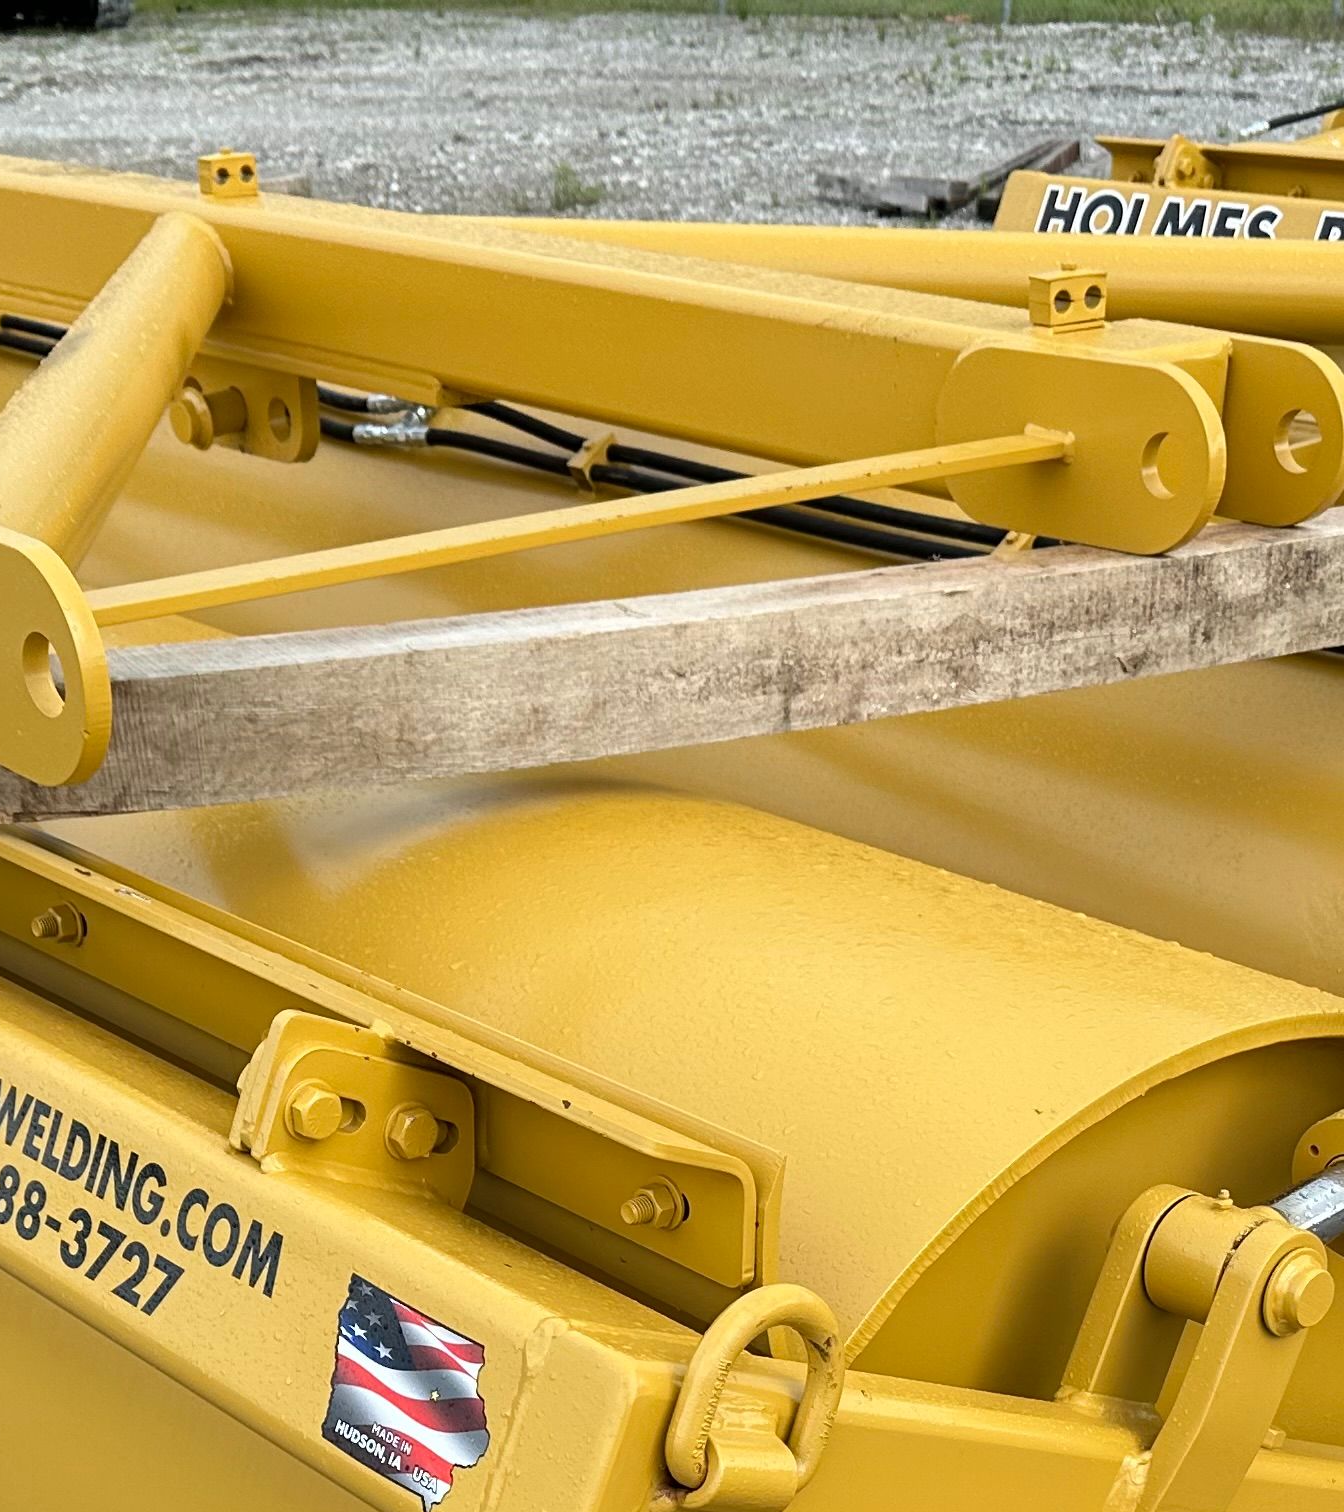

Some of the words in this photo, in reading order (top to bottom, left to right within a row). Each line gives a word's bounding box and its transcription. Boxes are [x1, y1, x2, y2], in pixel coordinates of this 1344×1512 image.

[335, 1419, 387, 1464] HUDSON,
[388, 1452, 402, 1471] IA
[412, 1467, 438, 1493] USA
[371, 1423, 401, 1449] MADE
[401, 1440, 413, 1456] IN
